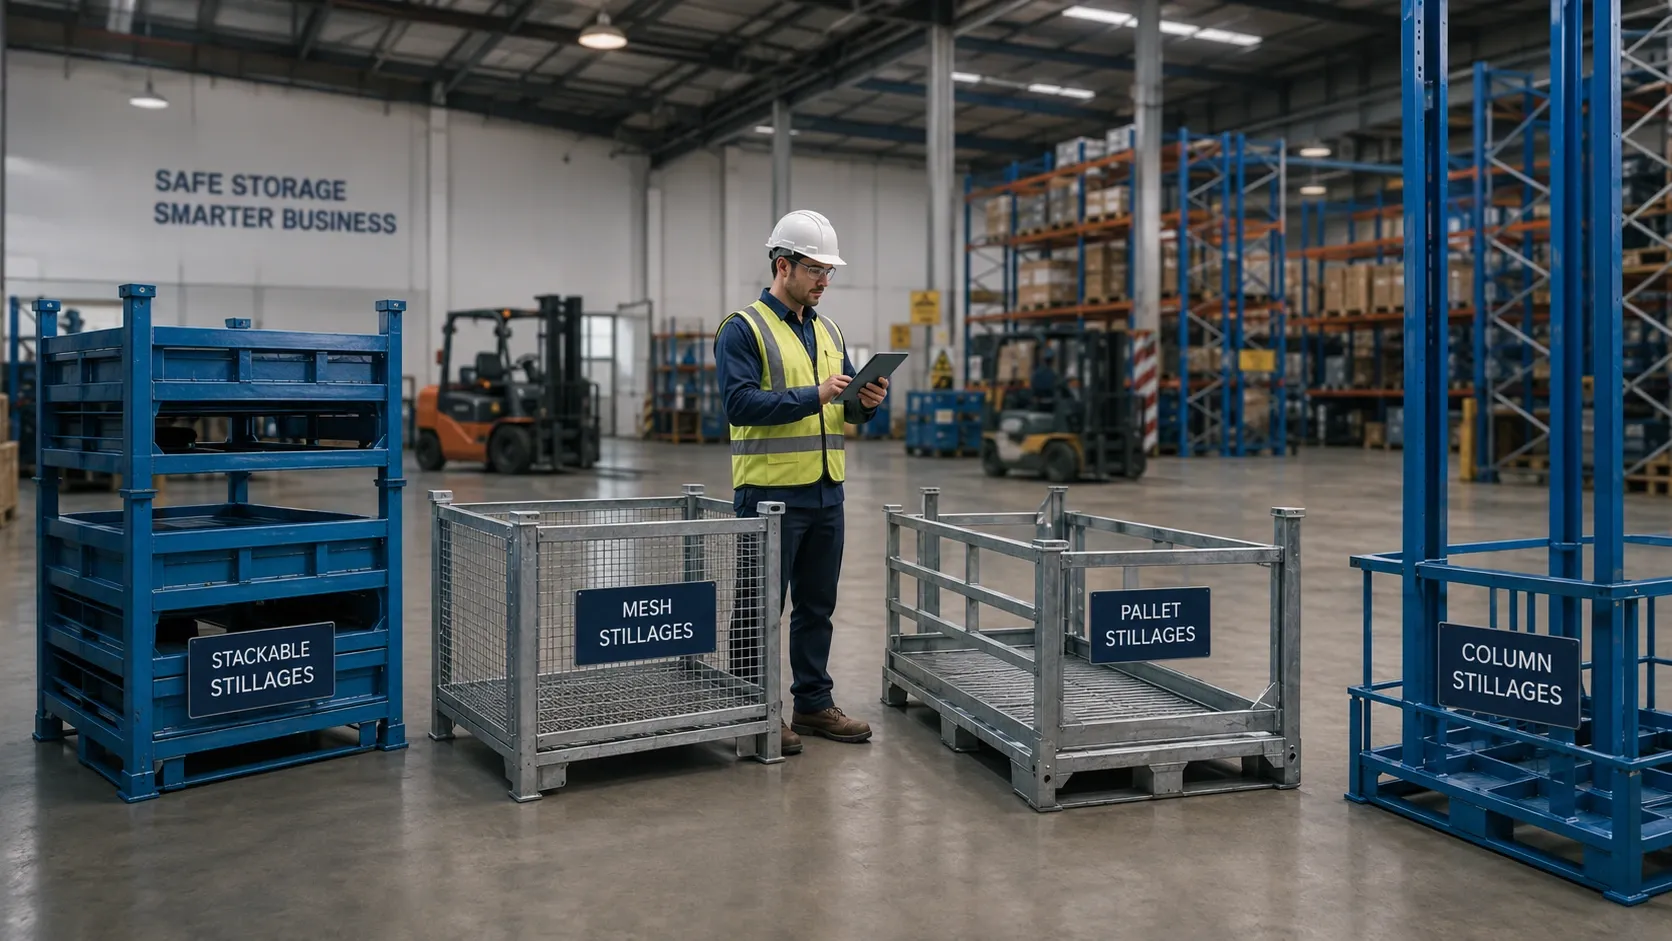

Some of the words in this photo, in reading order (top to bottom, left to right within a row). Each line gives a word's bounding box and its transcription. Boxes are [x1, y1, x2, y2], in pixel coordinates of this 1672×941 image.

[156, 170, 222, 194] SAFE
[232, 174, 345, 201] STORAGE
[155, 202, 273, 228] SMARTER
[283, 208, 396, 234] BUSINESS
[624, 599, 671, 617] MESH
[1122, 602, 1181, 620] PALLET
[600, 623, 693, 646] STILLAGES
[1106, 626, 1195, 646] STILLAGES
[213, 641, 309, 668] STACKABLE
[1463, 643, 1551, 672] COLUMN
[211, 666, 313, 696] STILLAGES
[1453, 671, 1562, 705] STILLAGES
